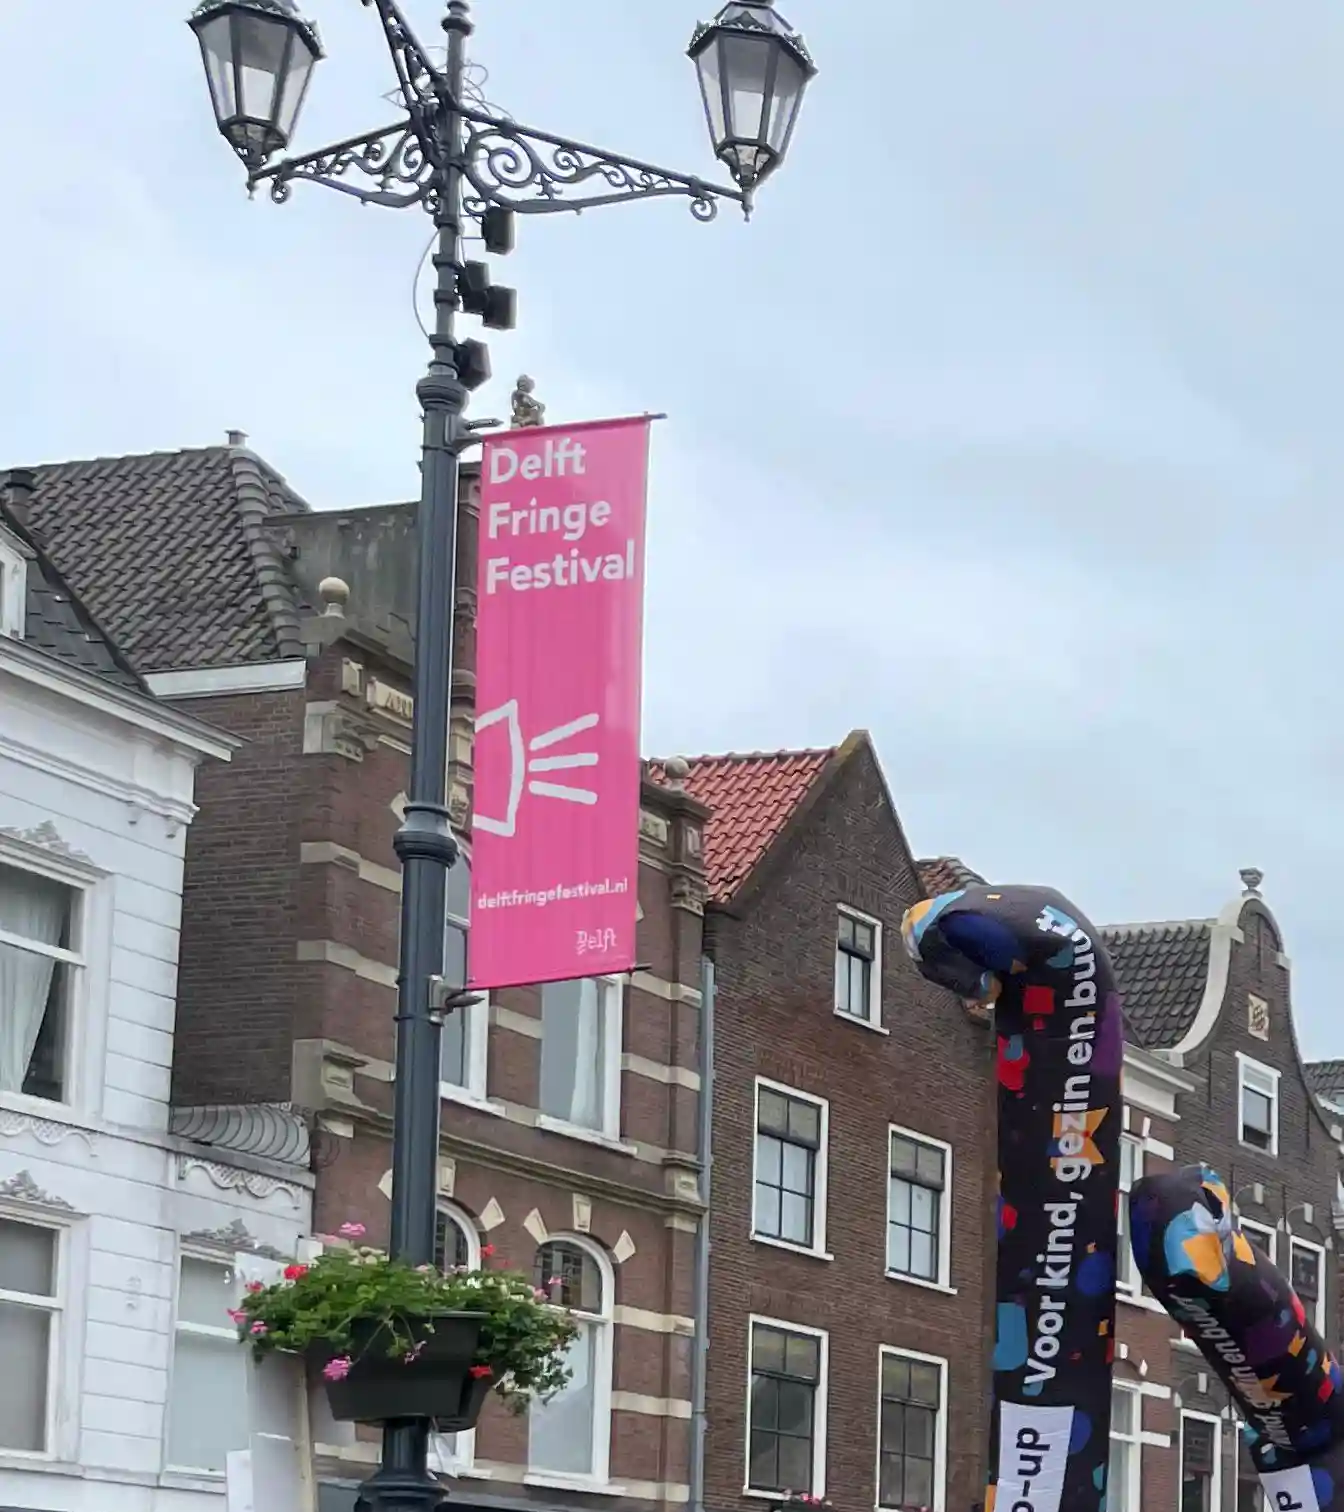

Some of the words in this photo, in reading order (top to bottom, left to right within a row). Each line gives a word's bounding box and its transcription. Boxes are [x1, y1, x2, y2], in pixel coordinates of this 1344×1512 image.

[489, 437, 587, 484] Delft
[488, 497, 612, 541] Fringe
[486, 539, 635, 595] Festival
[478, 877, 628, 909] delftfringefestival.nl
[576, 928, 617, 955] Delft
[1067, 1015, 1096, 1065] en
[1053, 1074, 1092, 1182] gezin
[1036, 1192, 1083, 1289] kind,
[1023, 1299, 1067, 1386] Voor
